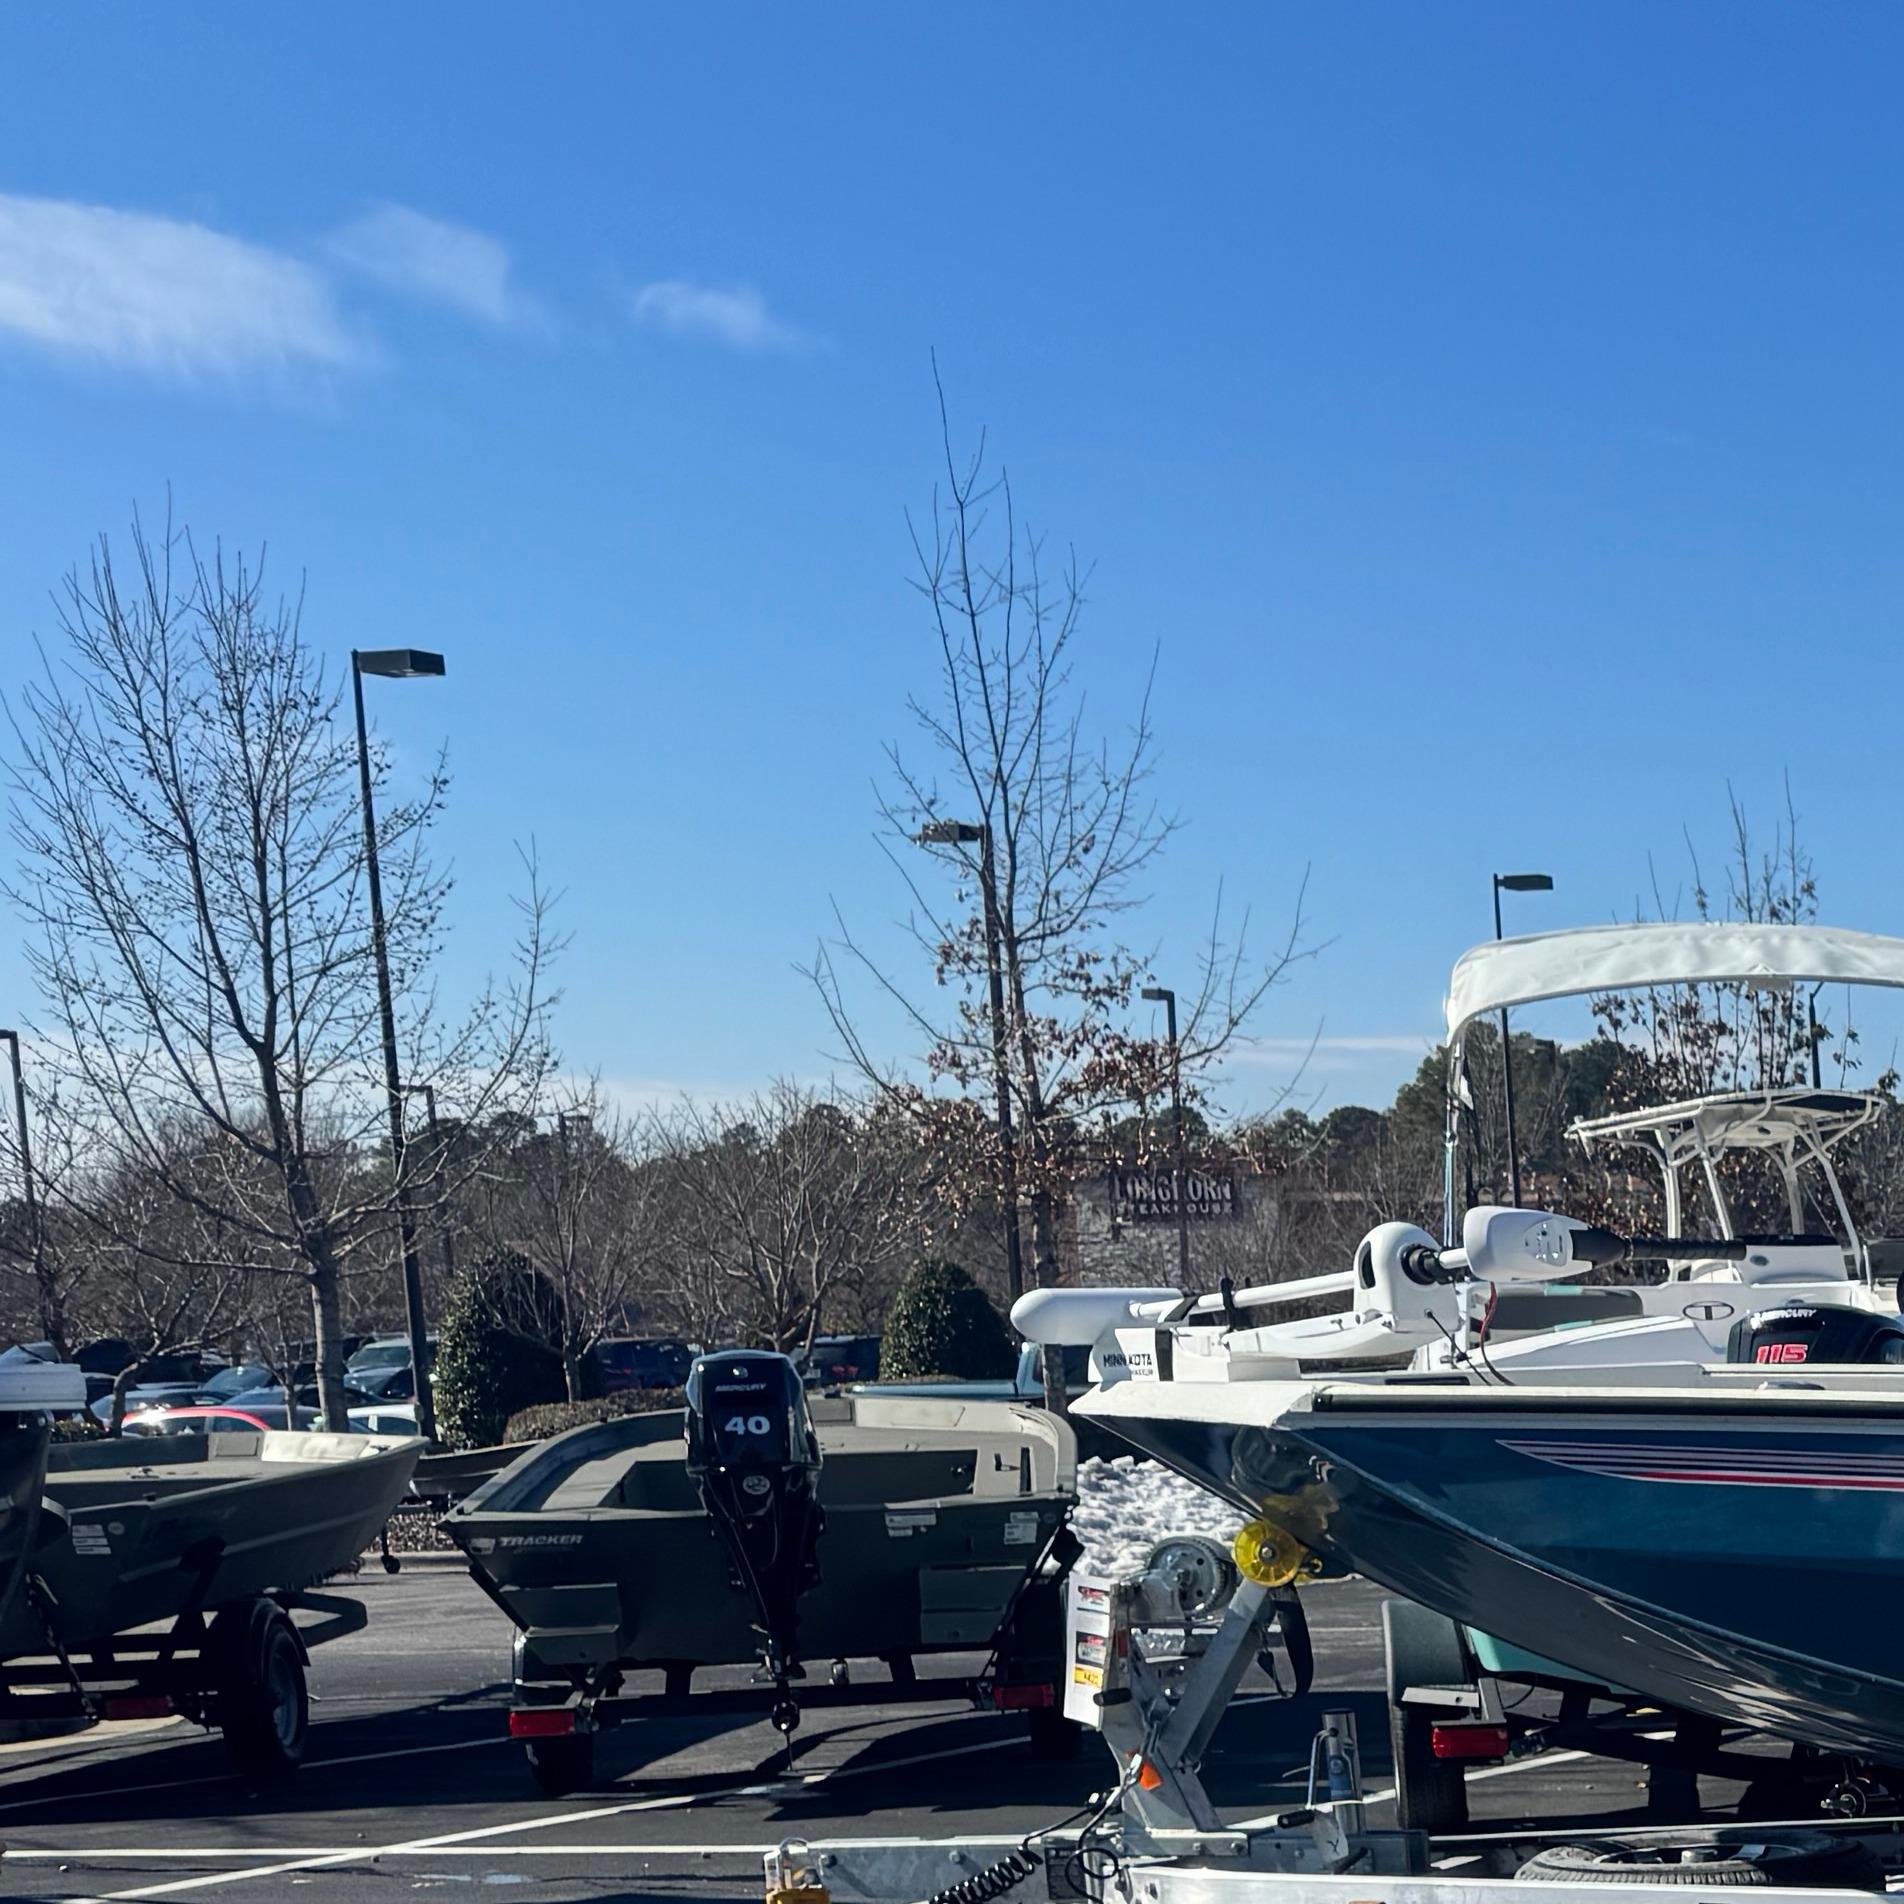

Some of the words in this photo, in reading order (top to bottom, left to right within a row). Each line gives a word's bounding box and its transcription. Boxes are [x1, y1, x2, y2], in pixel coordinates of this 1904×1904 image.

[1761, 1309, 1816, 1321] MERCURY
[1757, 1344, 1808, 1364] 115
[724, 1415, 771, 1435] 40
[500, 1535, 583, 1546] TRACKER
